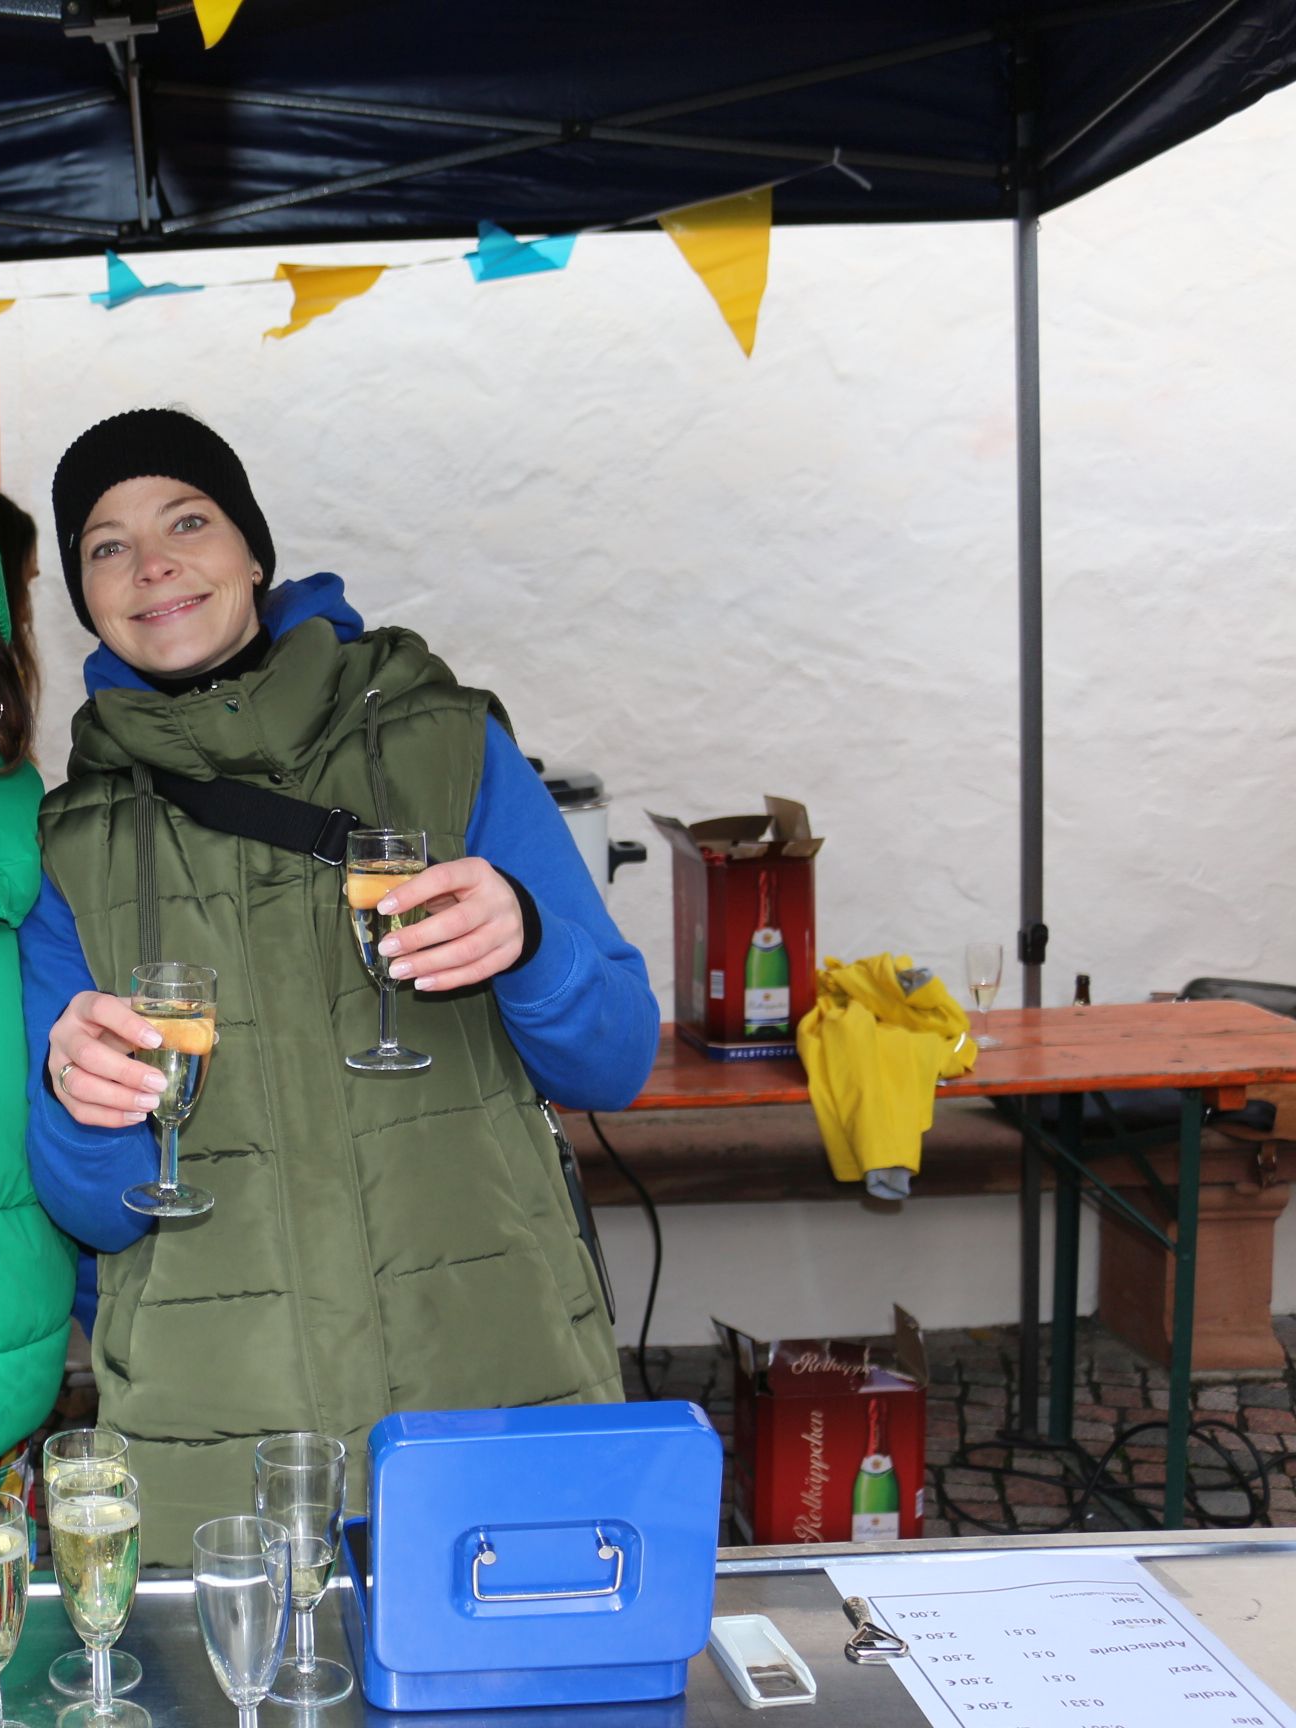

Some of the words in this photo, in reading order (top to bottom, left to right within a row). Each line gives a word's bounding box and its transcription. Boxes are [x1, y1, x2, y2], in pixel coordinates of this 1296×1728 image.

[729, 1048, 794, 1058] HALBTROCKE
[792, 1409, 830, 1543] Rotkäppchen
[896, 1611, 906, 1619] €
[1112, 1617, 1167, 1626] Wasser
[912, 1632, 922, 1640] €
[1089, 1639, 1186, 1656] Apfelschorle
[928, 1655, 939, 1663] €
[943, 1653, 975, 1662] 2,50
[1168, 1664, 1213, 1675] Spezi
[945, 1679, 956, 1687] €
[960, 1676, 993, 1686] 2,50
[1184, 1690, 1237, 1700] Radler
[963, 1703, 975, 1711] €
[978, 1701, 1013, 1711] 2,50
[1071, 1698, 1104, 1708] 0,33
[1231, 1716, 1263, 1726] Bier
